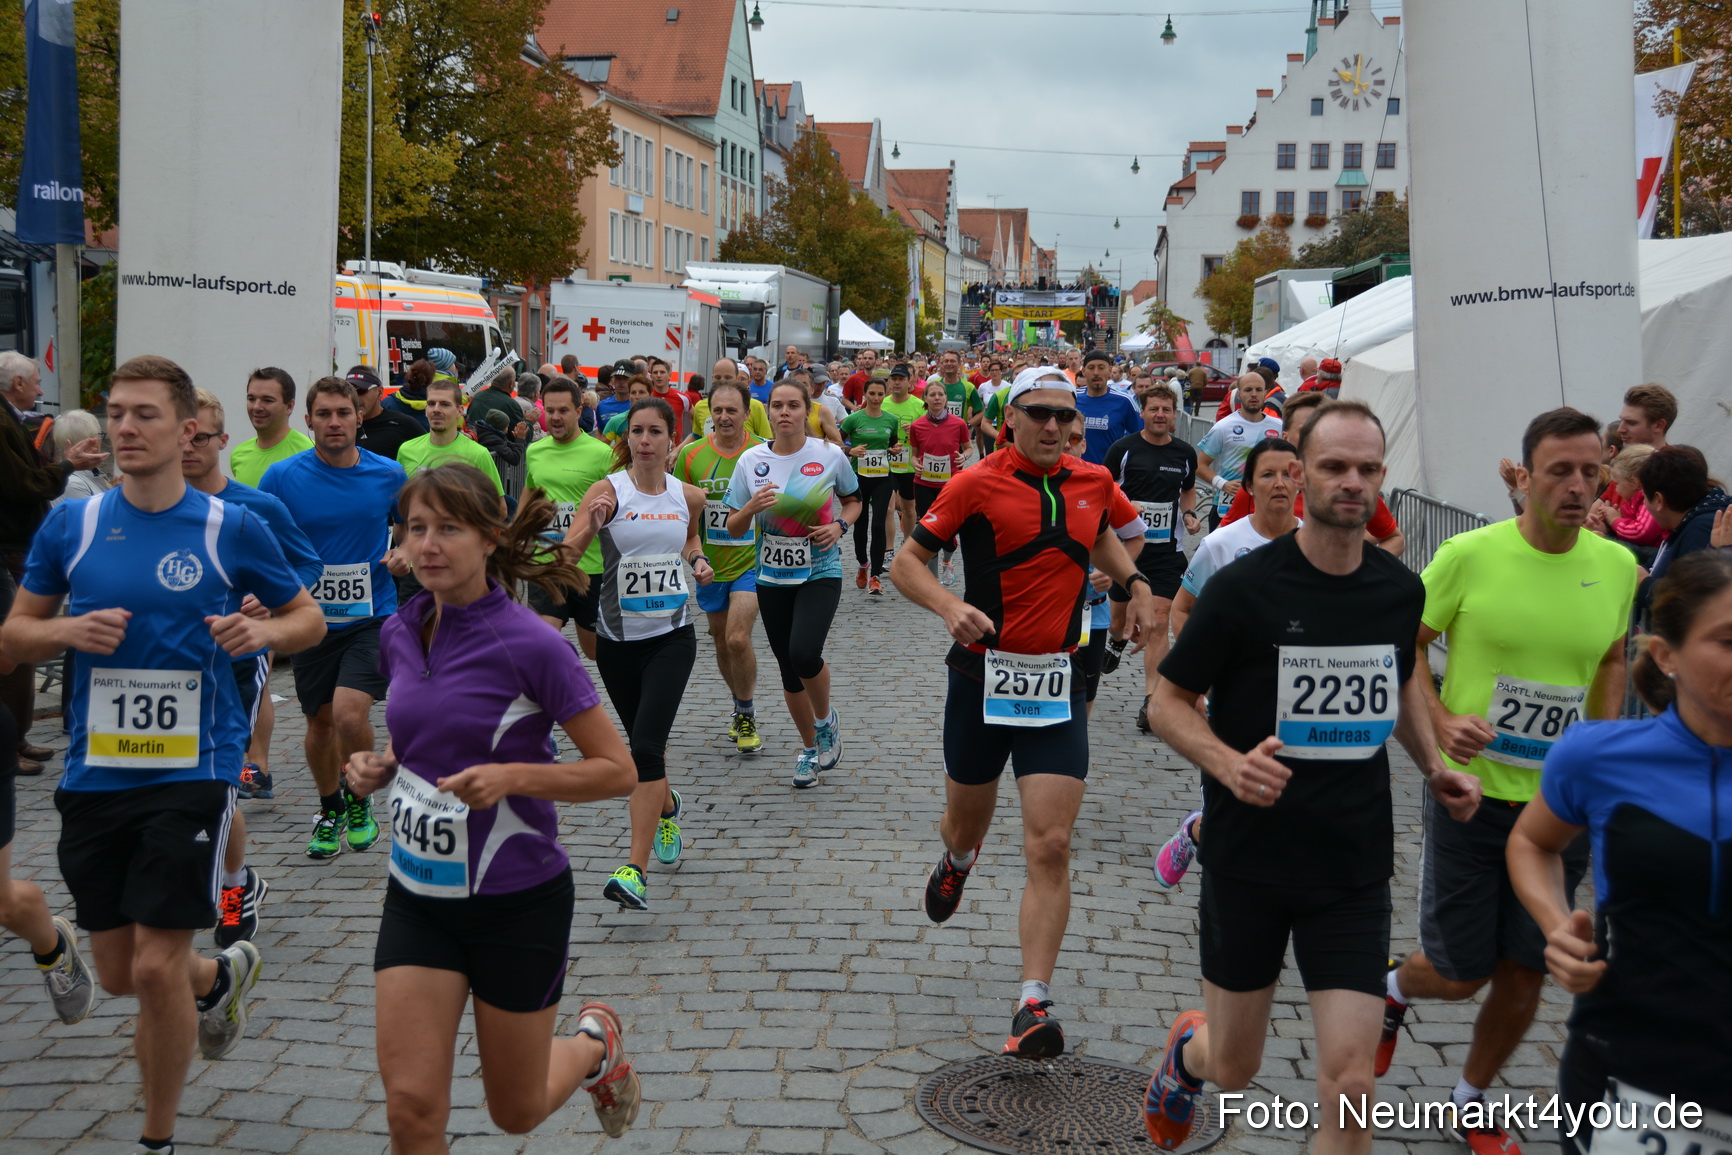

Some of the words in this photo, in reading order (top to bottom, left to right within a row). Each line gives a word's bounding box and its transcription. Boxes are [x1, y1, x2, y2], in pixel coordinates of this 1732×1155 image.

[122, 271, 297, 296] www.bmw-laufsport.de
[1450, 281, 1635, 306] www.bmw-laufsport.de
[610, 318, 653, 327] Bayerisches
[471, 356, 514, 392] bmw-laufsport.de
[865, 457, 882, 467] 187
[928, 461, 946, 472] 167
[641, 513, 682, 521] KLEBL
[1140, 512, 1169, 528] 591
[764, 546, 806, 566] 2463
[620, 561, 642, 569] PARTL
[311, 579, 365, 601] 2585
[625, 569, 681, 595] 2174
[325, 606, 349, 615] Franz
[646, 600, 665, 609] Lisa
[1017, 661, 1056, 669] Neumarkt
[1282, 658, 1324, 668] PARTL
[1328, 657, 1379, 668] Neumarkt
[94, 678, 126, 688] PARTL
[129, 679, 181, 689] Neumarkt
[994, 670, 1064, 697] 2570
[1291, 674, 1388, 715] 2236
[1496, 682, 1530, 697] PARTL
[1534, 691, 1577, 703] Neumarkt
[112, 693, 178, 730] 136
[1014, 704, 1040, 715] Sven
[1496, 698, 1579, 737] 2780
[1307, 727, 1370, 743] Andreas
[118, 739, 164, 754] Martin
[396, 777, 415, 798] PARTL
[391, 797, 456, 855] 2445
